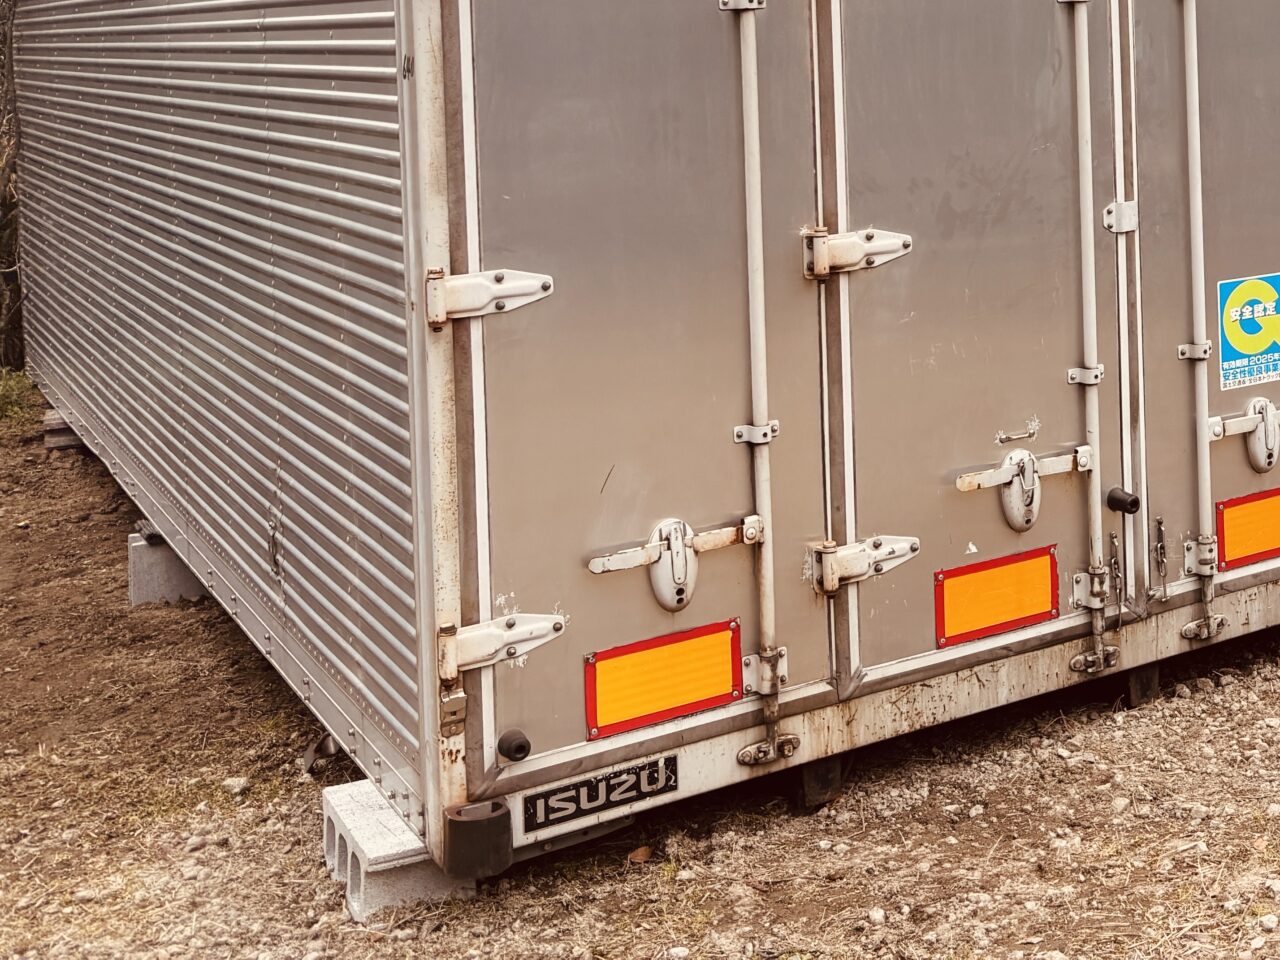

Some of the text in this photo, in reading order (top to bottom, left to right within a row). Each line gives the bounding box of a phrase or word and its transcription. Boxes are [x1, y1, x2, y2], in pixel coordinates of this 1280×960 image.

[1230, 301, 1277, 321] 安全認定
[536, 757, 667, 824] ISUZU
